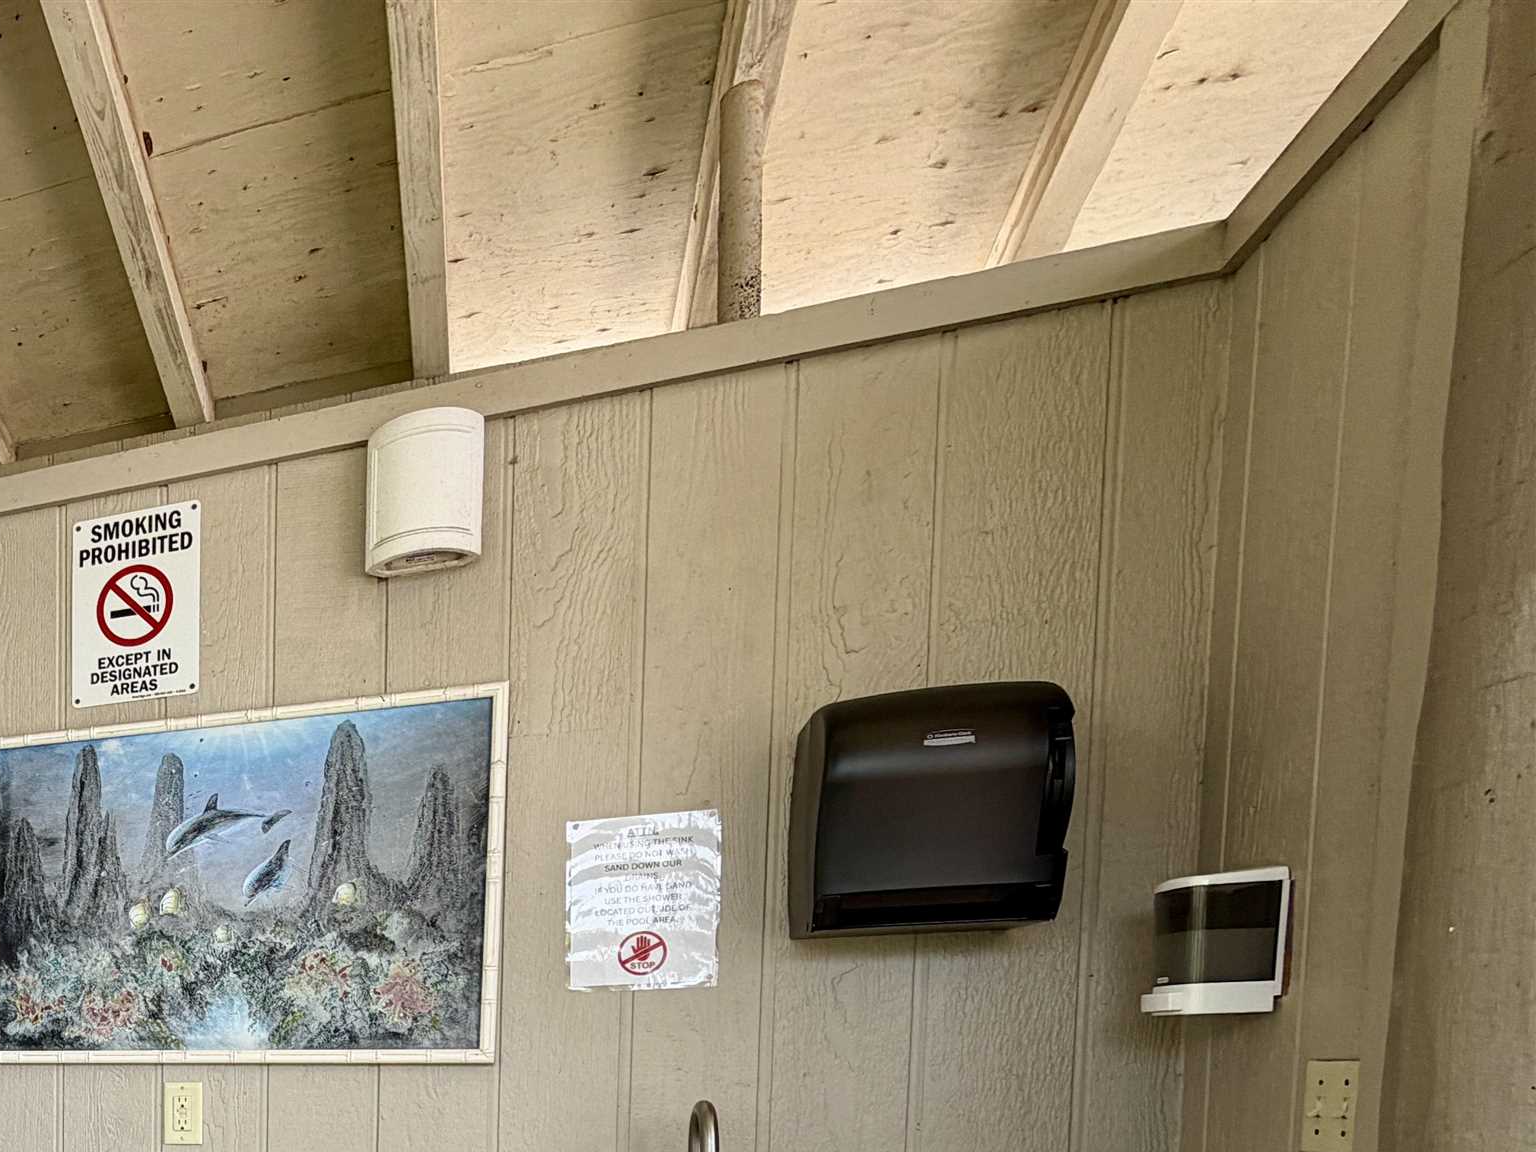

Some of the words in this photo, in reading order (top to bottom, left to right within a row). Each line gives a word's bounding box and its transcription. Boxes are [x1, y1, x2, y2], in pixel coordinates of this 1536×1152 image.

[90, 509, 182, 544] SMOKING
[79, 531, 193, 568] PROHIBITED
[97, 650, 152, 671] EXCEPT
[157, 648, 172, 662] IN
[90, 661, 179, 686] DESIGNATED
[110, 678, 158, 697] AREAS
[672, 836, 695, 844] SINK
[604, 863, 630, 873] SAND
[631, 861, 660, 871] DOWN
[662, 859, 683, 868] OUR
[624, 884, 639, 893] DO
[604, 896, 622, 905] USE
[623, 895, 642, 904] THE
[594, 905, 636, 917] LOCATED
[625, 916, 651, 926] POOL
[630, 961, 656, 970] STOP
